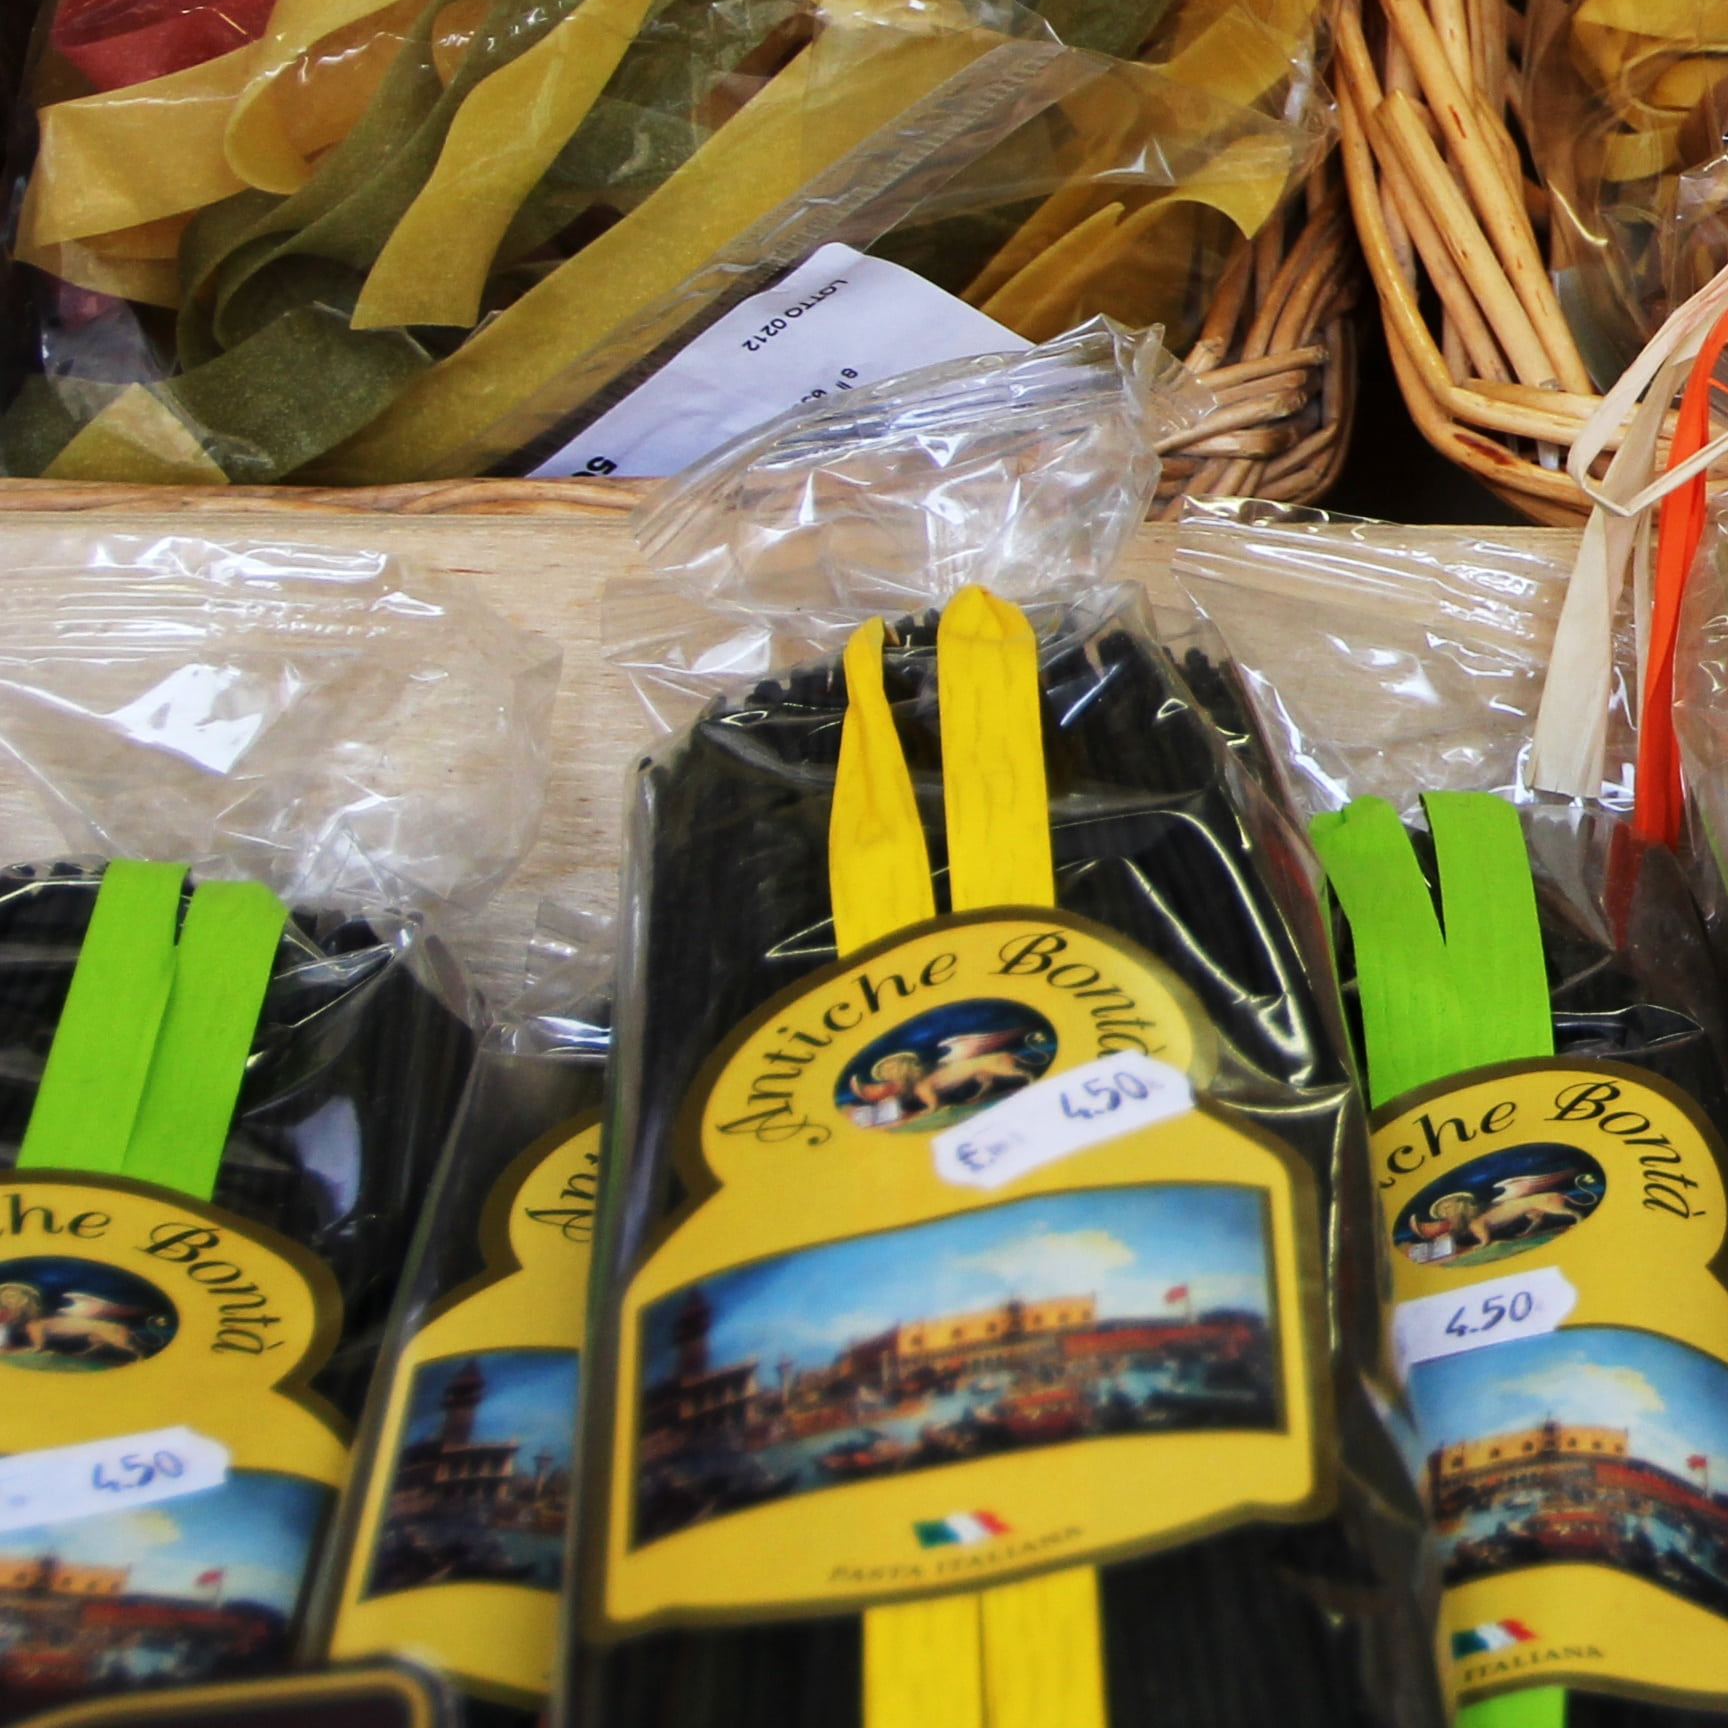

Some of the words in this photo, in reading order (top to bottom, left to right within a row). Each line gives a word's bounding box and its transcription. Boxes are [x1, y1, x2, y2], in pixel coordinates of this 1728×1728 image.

[742, 318, 787, 352] 0212
[784, 278, 848, 319] LOTTO
[715, 952, 958, 1147] Antiche
[1544, 1080, 1706, 1219] Bontà
[134, 1222, 285, 1356] Bontà
[1445, 1291, 1533, 1337] 4.50
